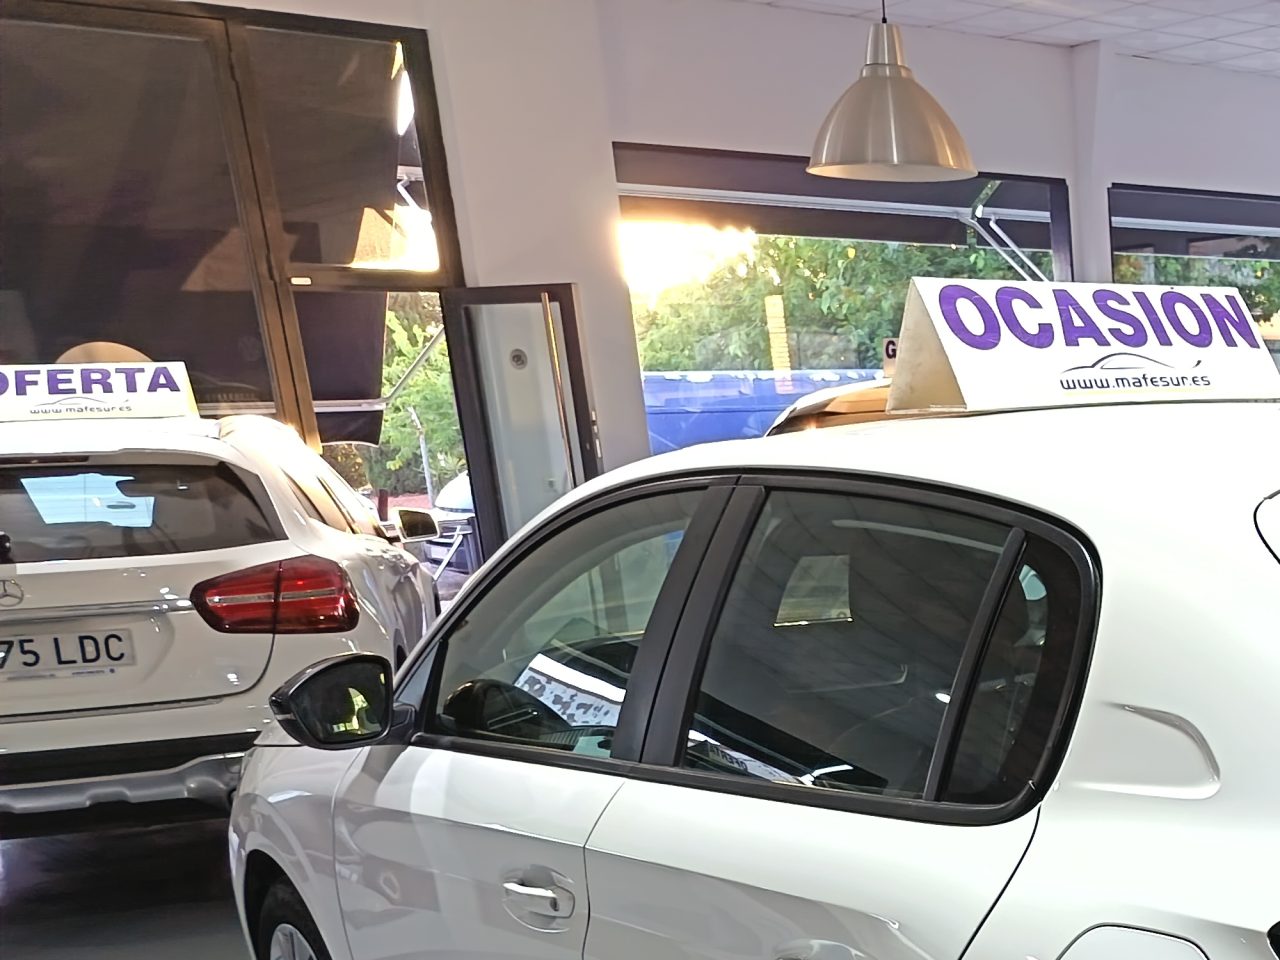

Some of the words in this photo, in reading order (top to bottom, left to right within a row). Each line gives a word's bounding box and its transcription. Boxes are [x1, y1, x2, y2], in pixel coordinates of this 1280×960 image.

[0, 366, 181, 396] FERTA
[1060, 373, 1211, 390] www.mafesur.es
[29, 405, 133, 415] wwwmafesures
[53, 633, 125, 666] LDC
